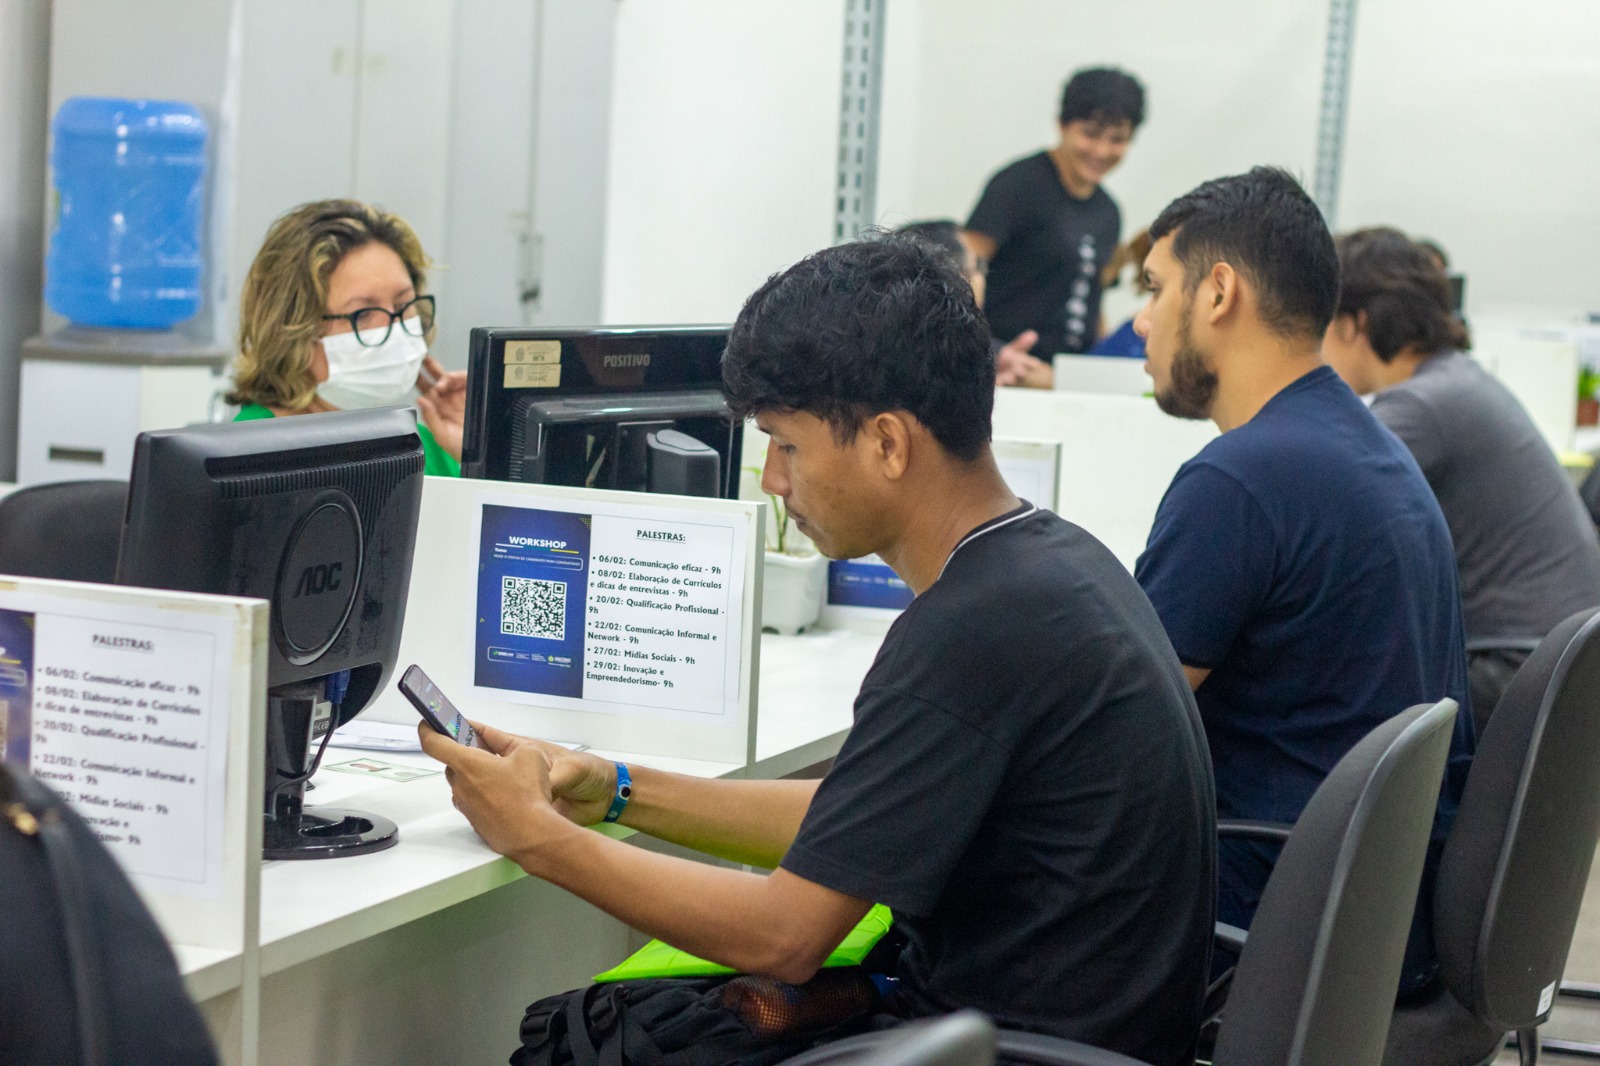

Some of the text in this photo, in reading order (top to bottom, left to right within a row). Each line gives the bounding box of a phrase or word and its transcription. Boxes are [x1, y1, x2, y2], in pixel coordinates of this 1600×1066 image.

[604, 354, 650, 367] POSITIVO
[508, 536, 566, 548] WORKSHOP
[637, 530, 685, 542] PALESTRAS:
[599, 555, 626, 565] 06/02:
[629, 558, 678, 571] Comunicação
[682, 564, 702, 572] eficaz
[294, 562, 342, 597] AOC
[598, 570, 625, 579] 08/02:
[629, 573, 668, 584] Elaboração
[684, 578, 721, 589] Currículos
[597, 581, 615, 590] dicas
[630, 586, 669, 595] entrevistas
[596, 596, 623, 605] 20/02:
[627, 599, 671, 611] Qualificação
[675, 604, 718, 615] Profissional
[588, 632, 620, 642] Network
[595, 621, 622, 631] 22/02:
[625, 625, 674, 637] Comunicação
[678, 630, 709, 640] Informal
[92, 634, 154, 651] PALESTRAS:
[594, 647, 621, 656] 27/02:
[624, 650, 648, 660] Mídias
[652, 653, 676, 662] Sociais
[594, 661, 620, 671] 29/02:
[624, 664, 657, 675] Inovação
[587, 672, 660, 686] Empreendedorismo-
